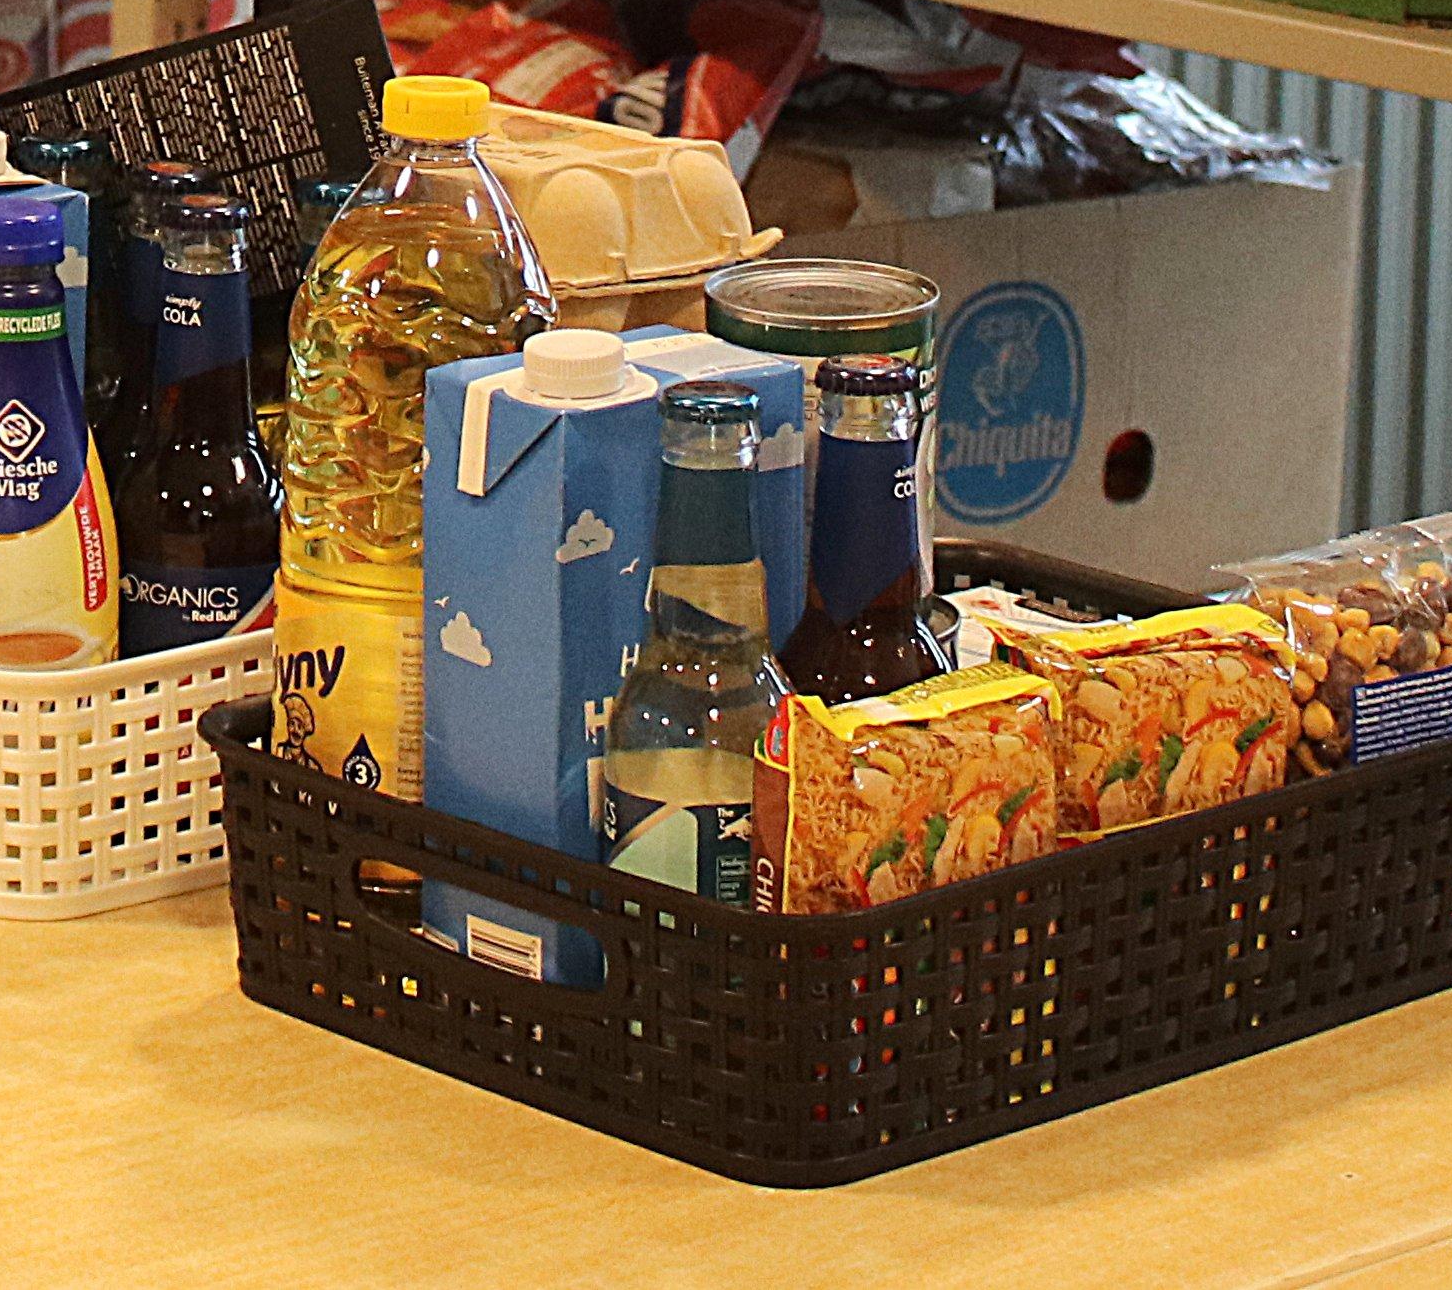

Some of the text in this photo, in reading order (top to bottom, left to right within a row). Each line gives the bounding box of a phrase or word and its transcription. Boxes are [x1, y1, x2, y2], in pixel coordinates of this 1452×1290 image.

[354, 56, 382, 118] Buiteman
[356, 109, 375, 144] since
[162, 306, 202, 329] COLA
[78, 505, 98, 608] VERTROUWDE
[92, 528, 105, 580] SMAAK
[120, 575, 240, 610] ORGANICS
[192, 609, 216, 623] Red
[218, 609, 239, 623] Bull
[352, 760, 369, 784] 3
